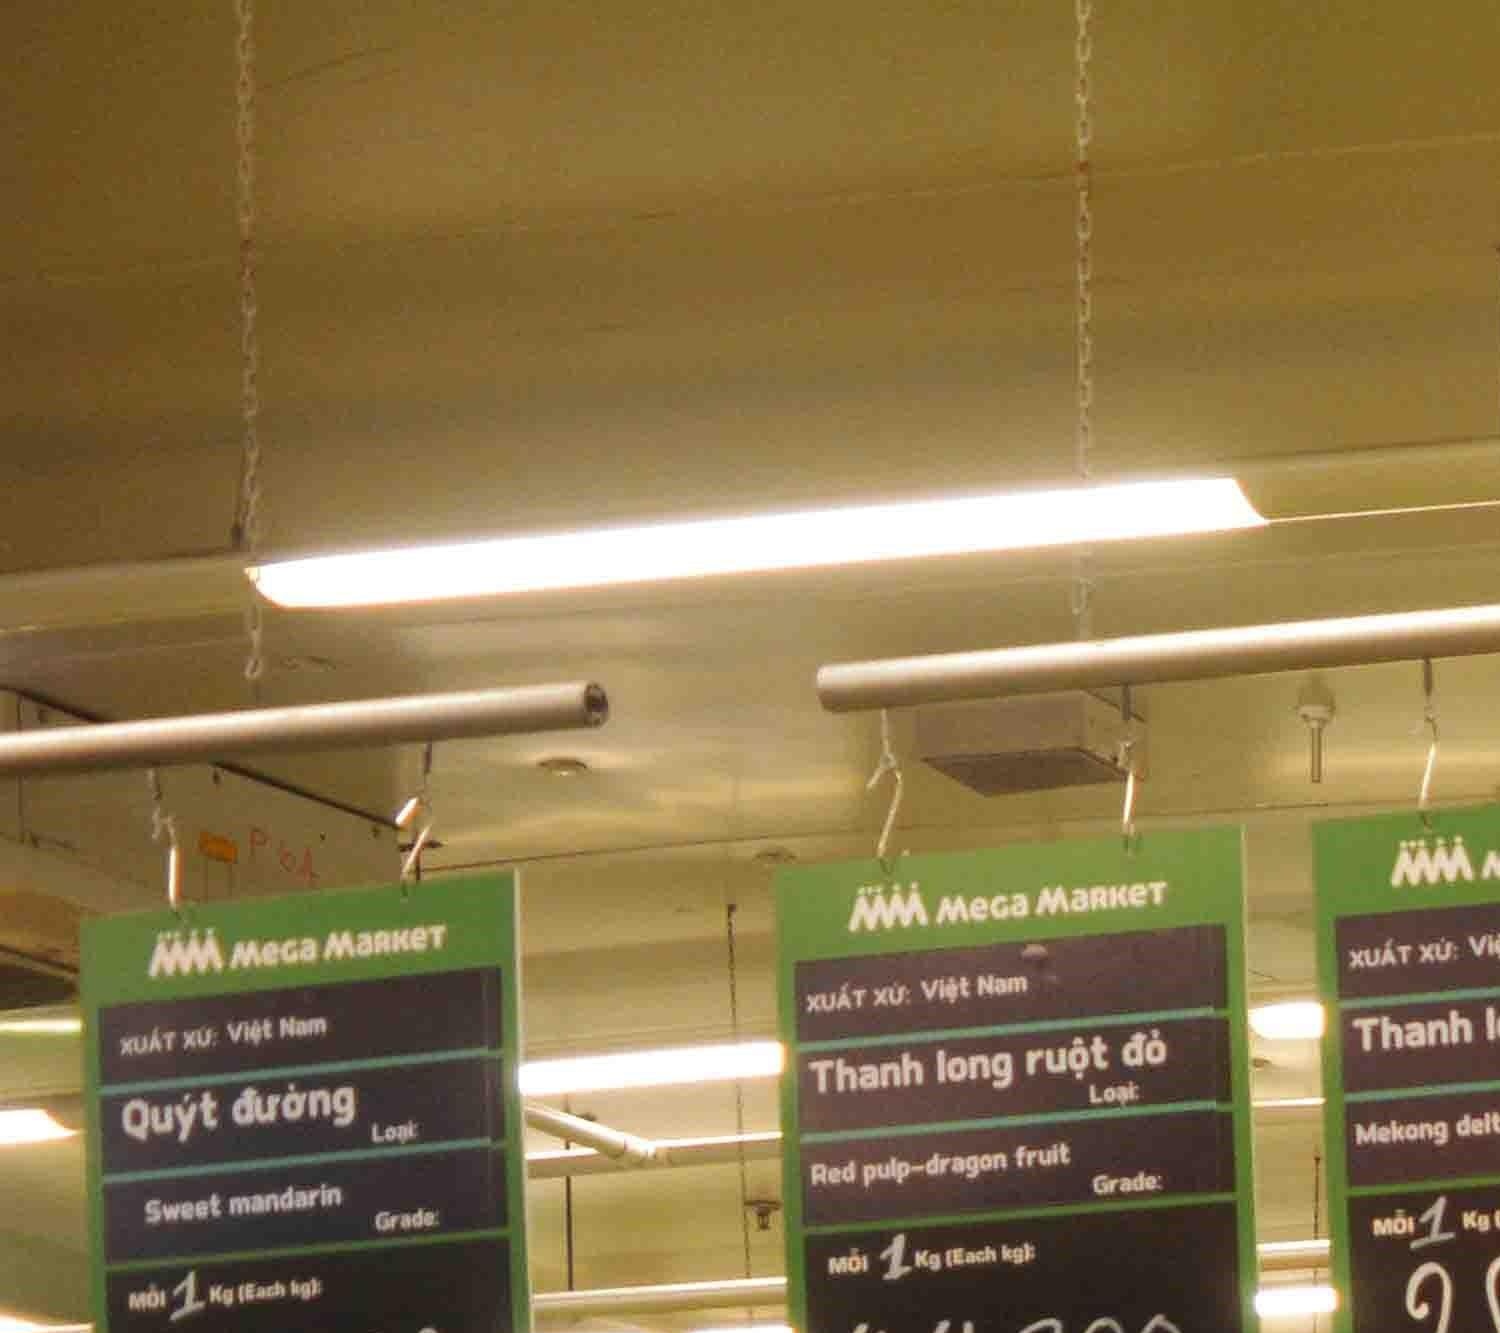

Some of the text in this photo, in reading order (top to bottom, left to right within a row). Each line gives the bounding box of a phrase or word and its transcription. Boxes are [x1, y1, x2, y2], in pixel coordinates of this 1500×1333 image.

[279, 1016, 327, 1037] Nam
[1352, 1013, 1473, 1052] Thanh
[809, 1029, 1168, 1094] Thanh long ruột đỏ
[122, 1094, 218, 1141] Quýt
[1355, 1117, 1448, 1146] Mekong
[810, 1161, 856, 1185] Red
[1015, 1142, 1071, 1169] fruit
[145, 1184, 342, 1224] Sweet mandarin
